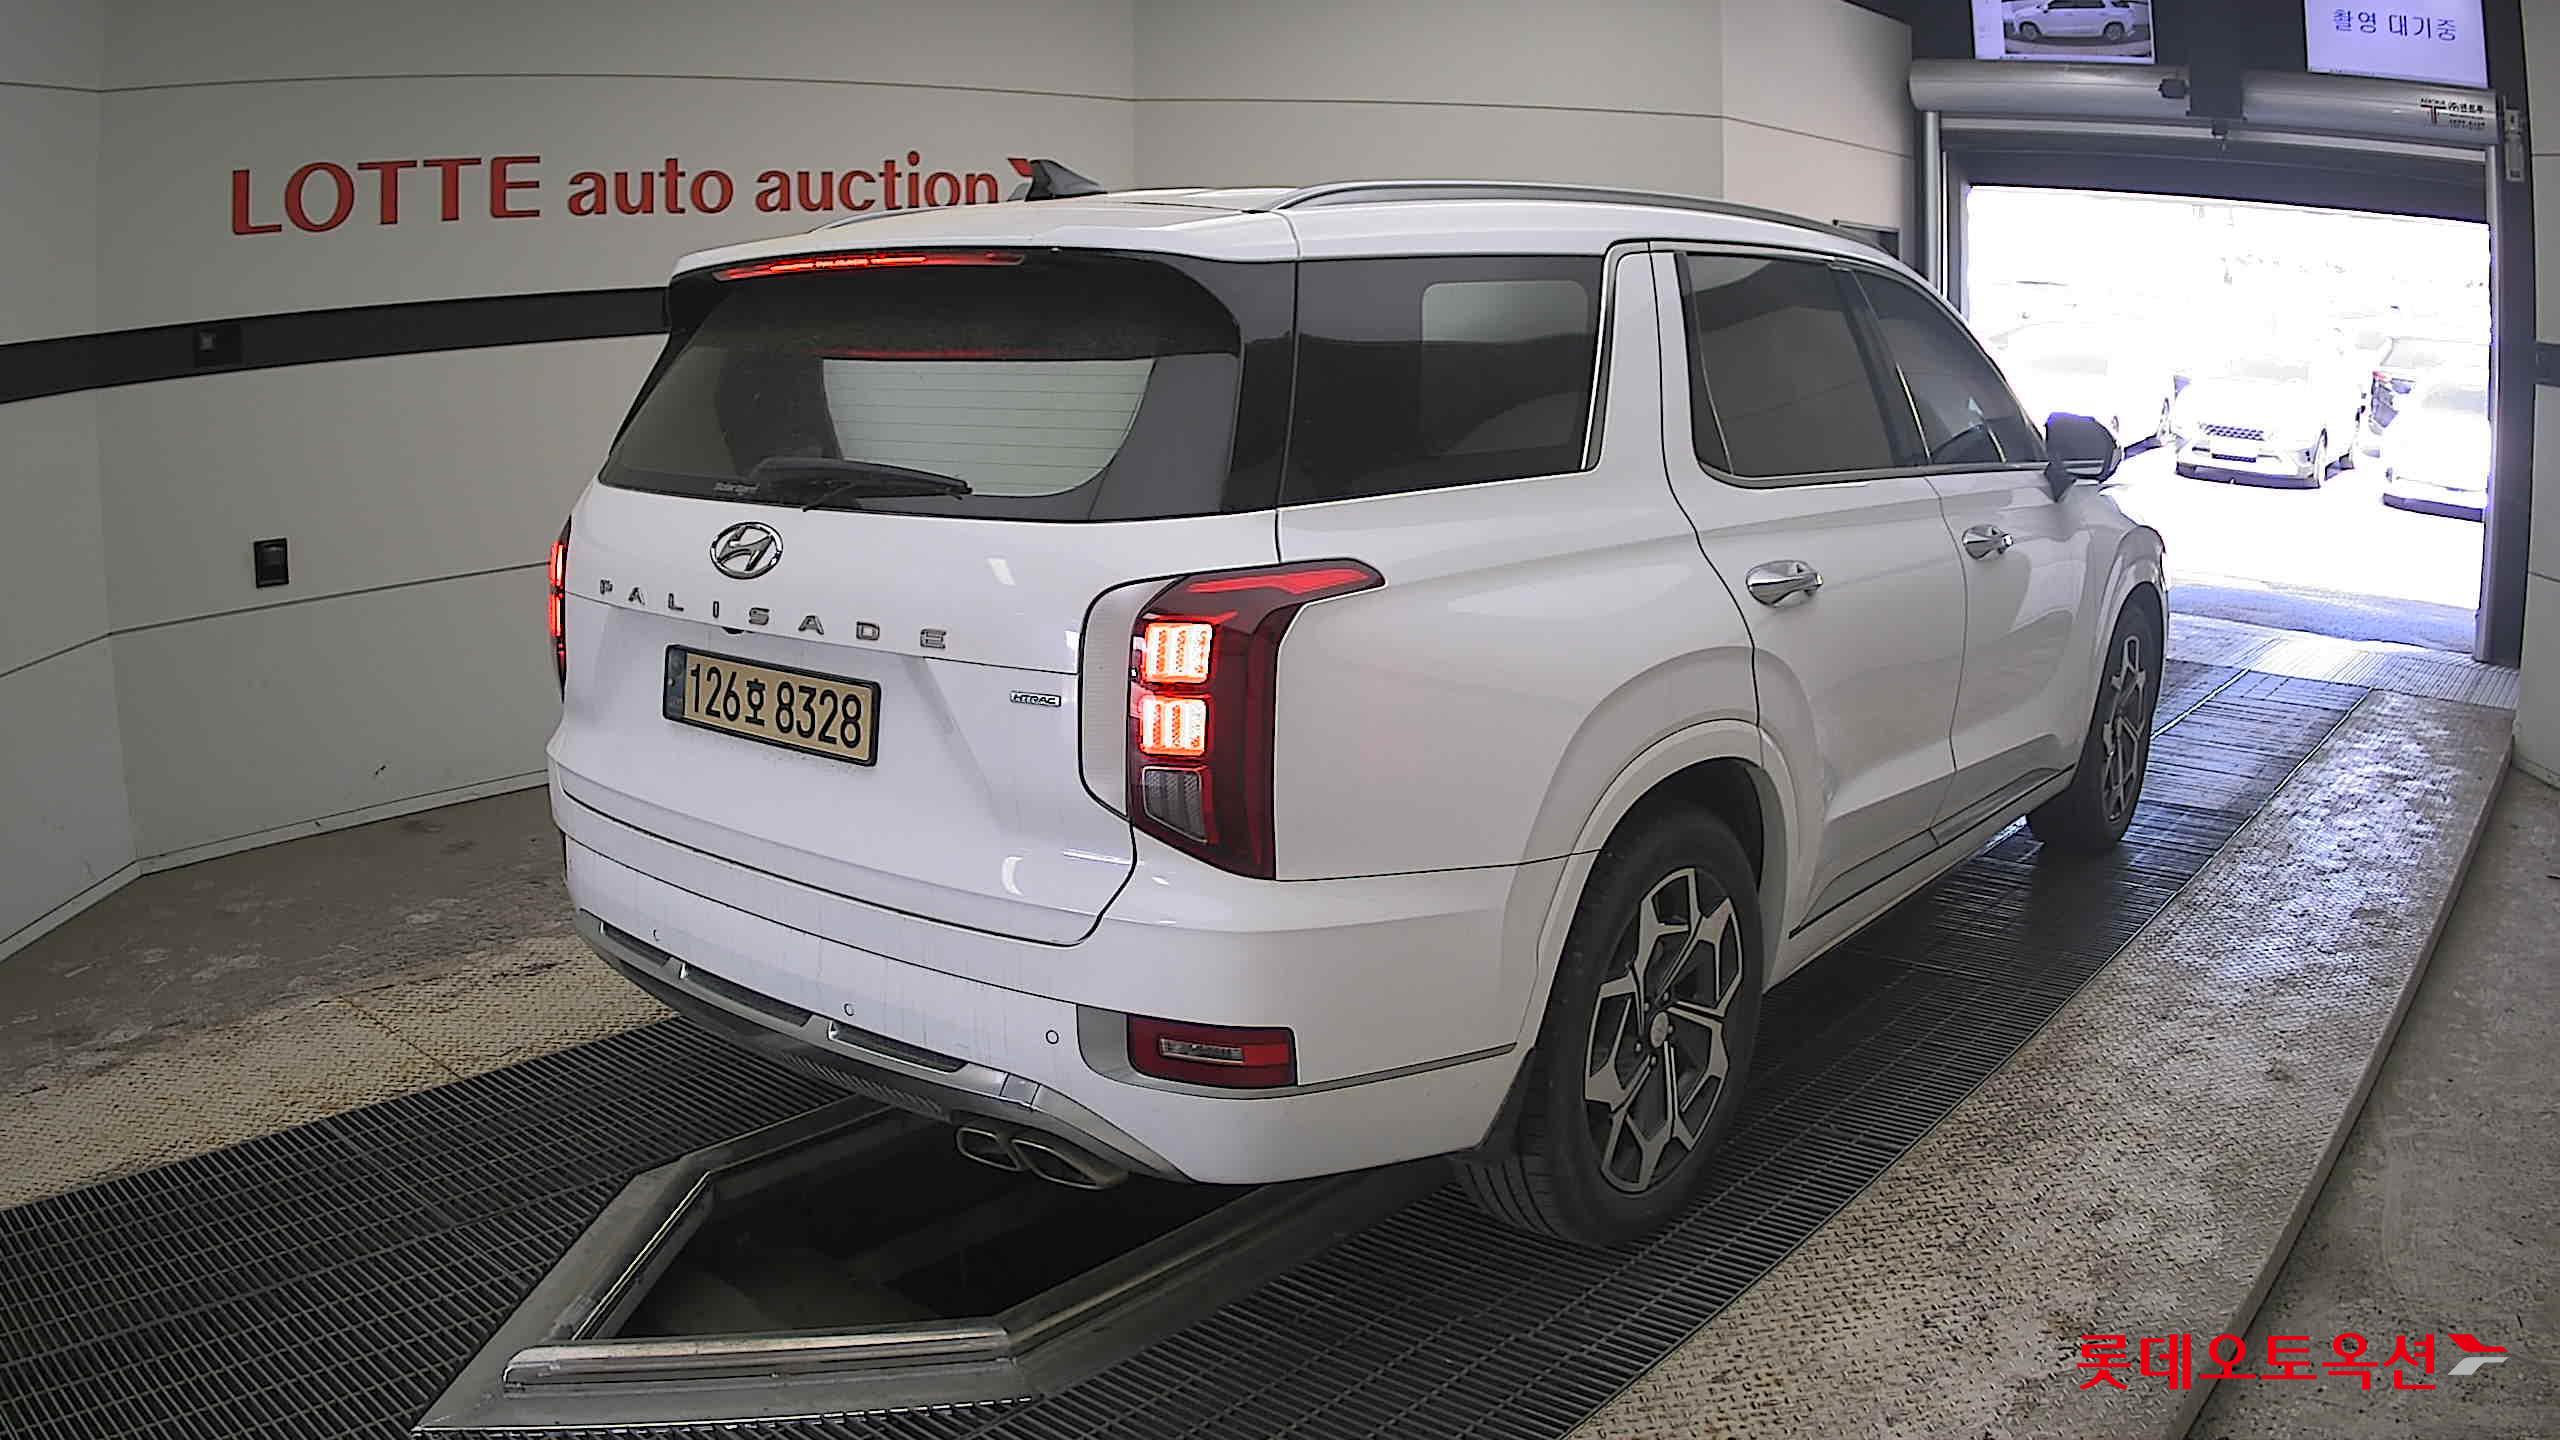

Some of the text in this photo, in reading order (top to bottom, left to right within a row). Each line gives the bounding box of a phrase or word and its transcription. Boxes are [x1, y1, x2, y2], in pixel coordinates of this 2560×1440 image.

[2333, 9, 2457, 42] 촬영 대기중
[232, 150, 1000, 235] LOTTE auto auction
[599, 579, 947, 650] PALISADE
[690, 663, 862, 749] 126호 8328
